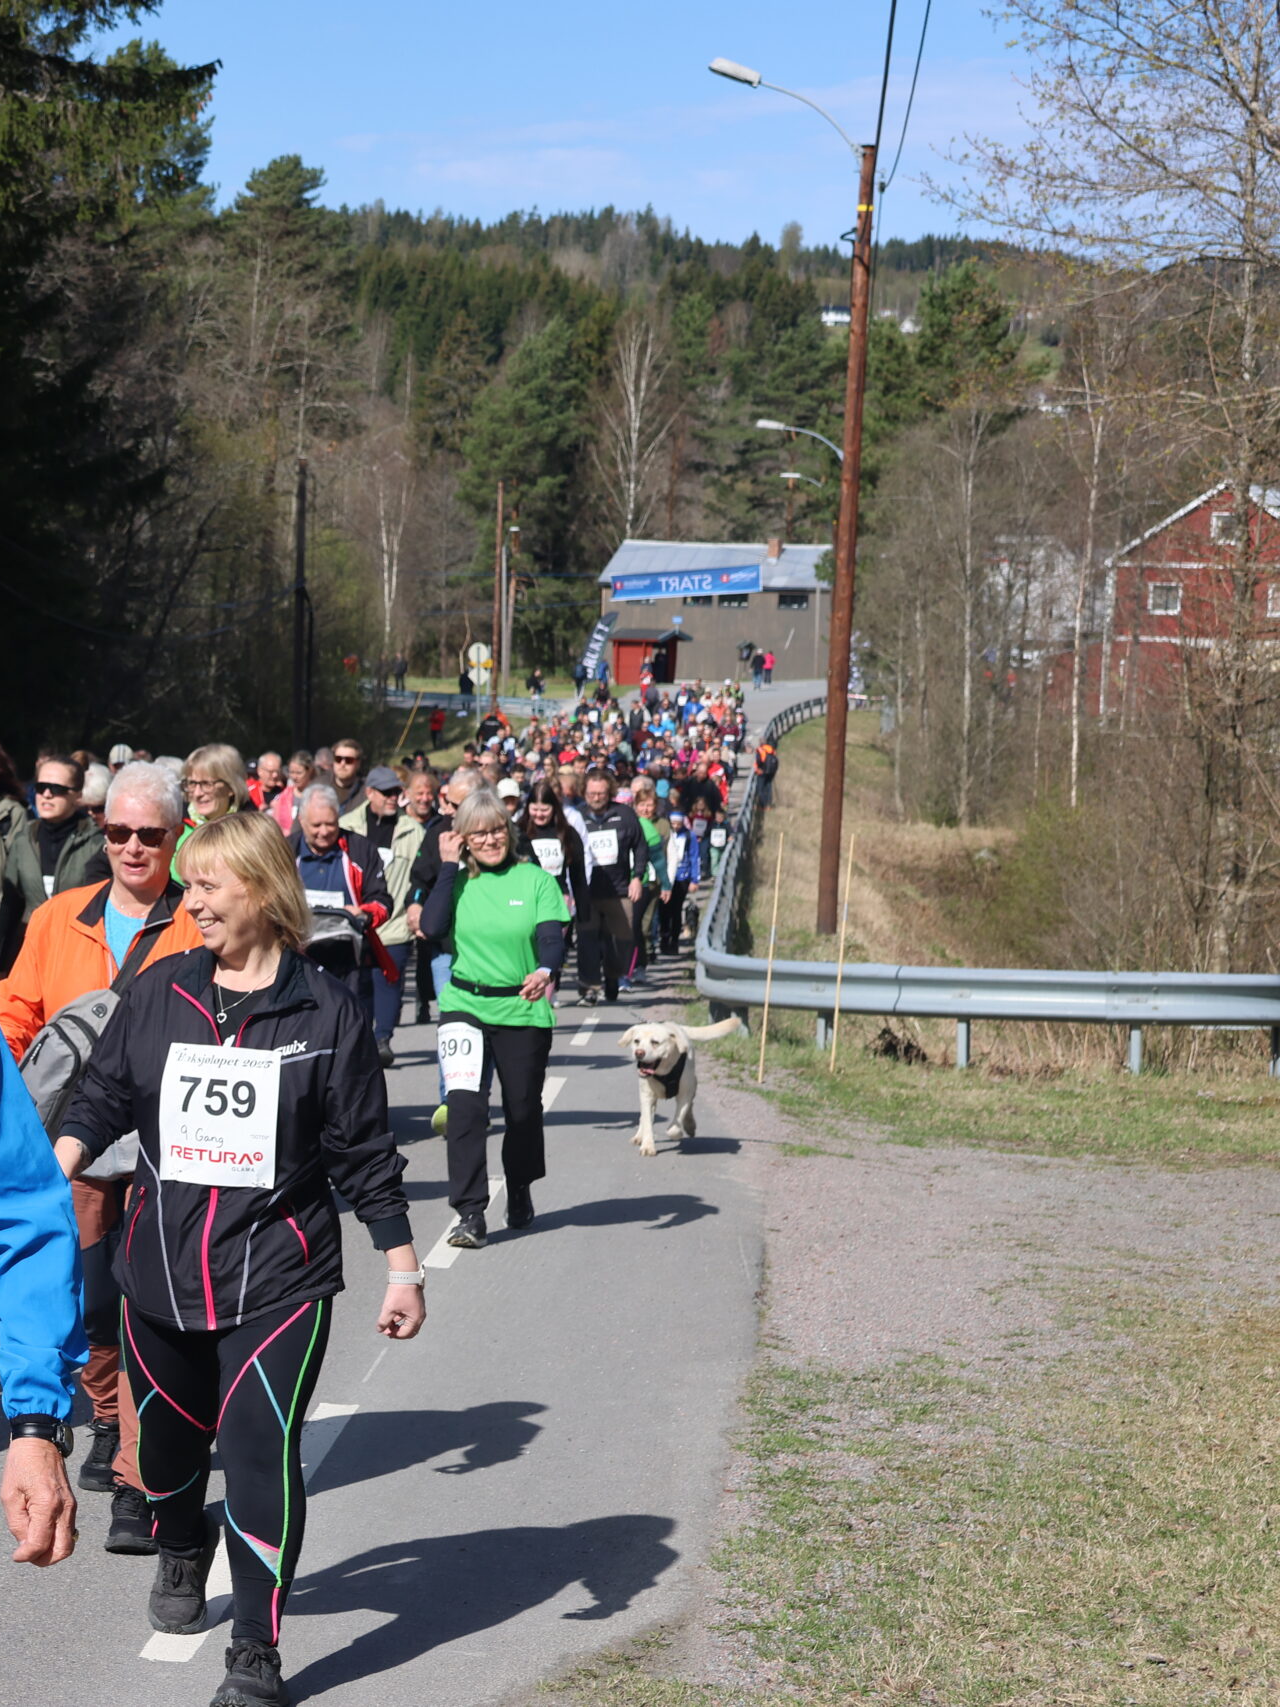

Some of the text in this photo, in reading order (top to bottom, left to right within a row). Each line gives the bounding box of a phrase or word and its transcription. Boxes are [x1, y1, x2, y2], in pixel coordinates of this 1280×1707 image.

[537, 847, 559, 858] 394
[592, 838, 612, 849] 653
[441, 1038, 472, 1060] 390
[179, 1075, 257, 1119] 759
[180, 1124, 224, 1148] 9 Gang
[170, 1144, 253, 1165] RETURA
